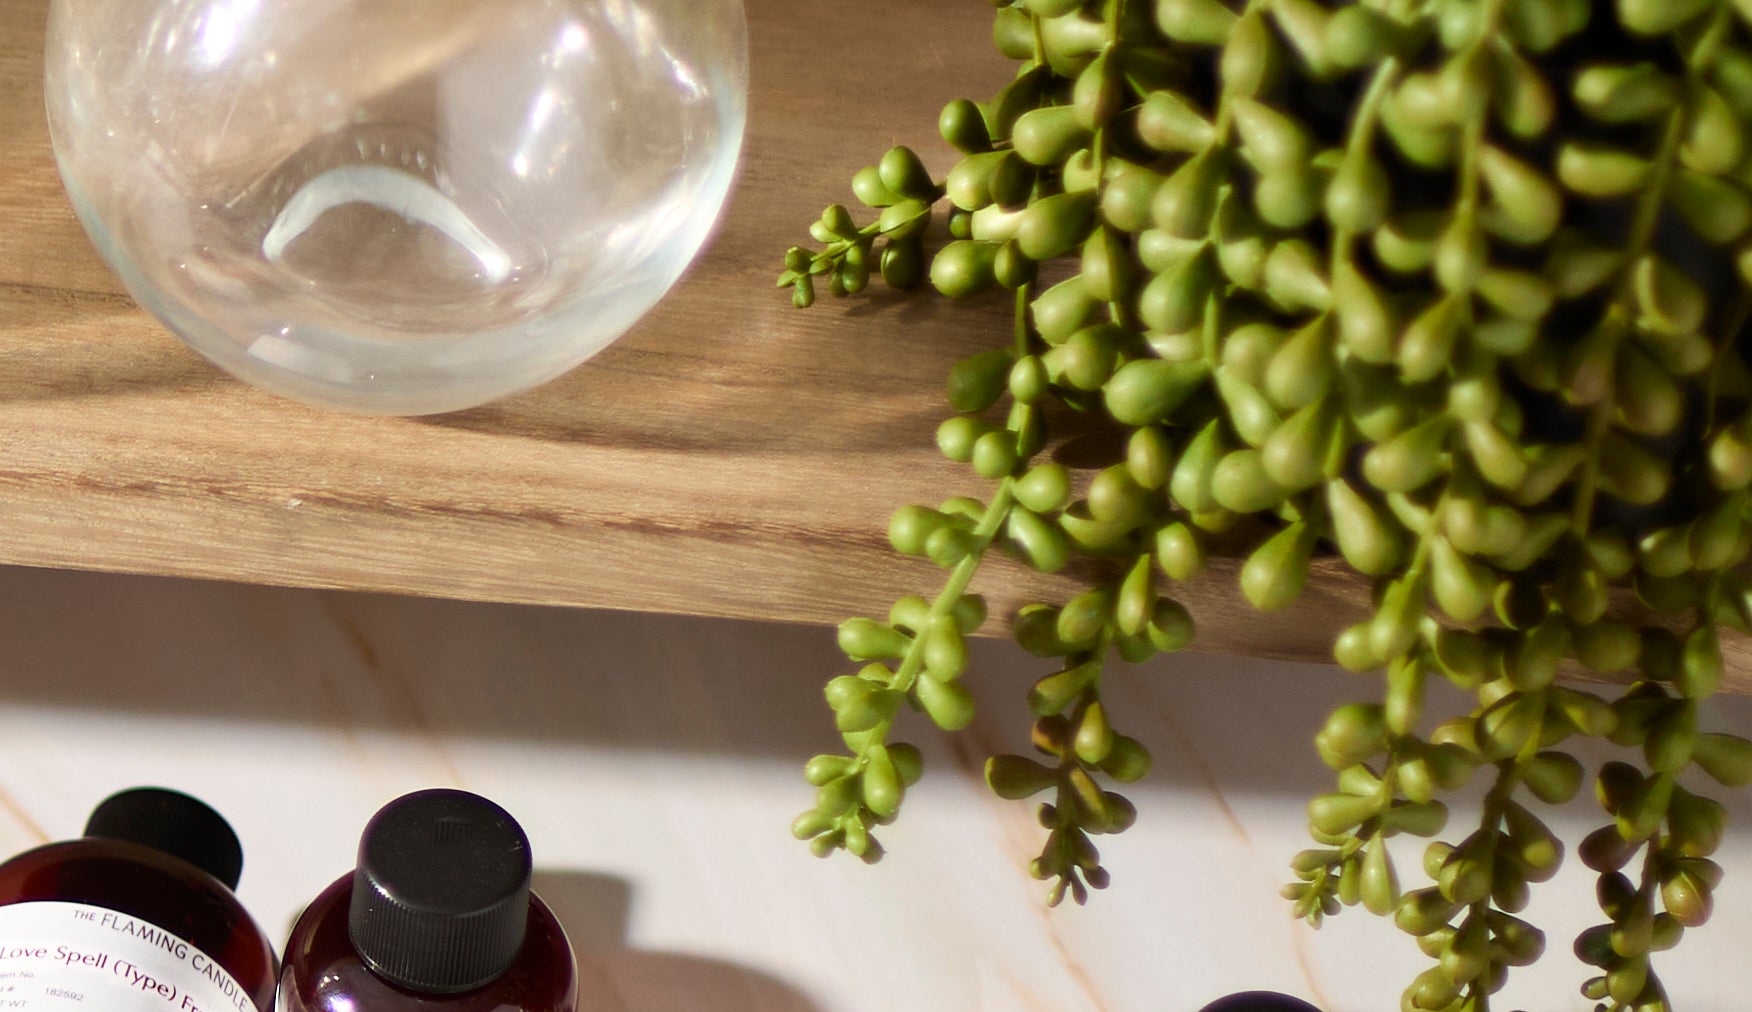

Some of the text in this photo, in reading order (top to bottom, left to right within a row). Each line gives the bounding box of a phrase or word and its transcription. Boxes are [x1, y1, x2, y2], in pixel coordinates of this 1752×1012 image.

[73, 909, 95, 921] THE
[101, 912, 188, 960] FLAMING
[54, 945, 108, 970] Spell
[113, 959, 177, 1001] (Type)
